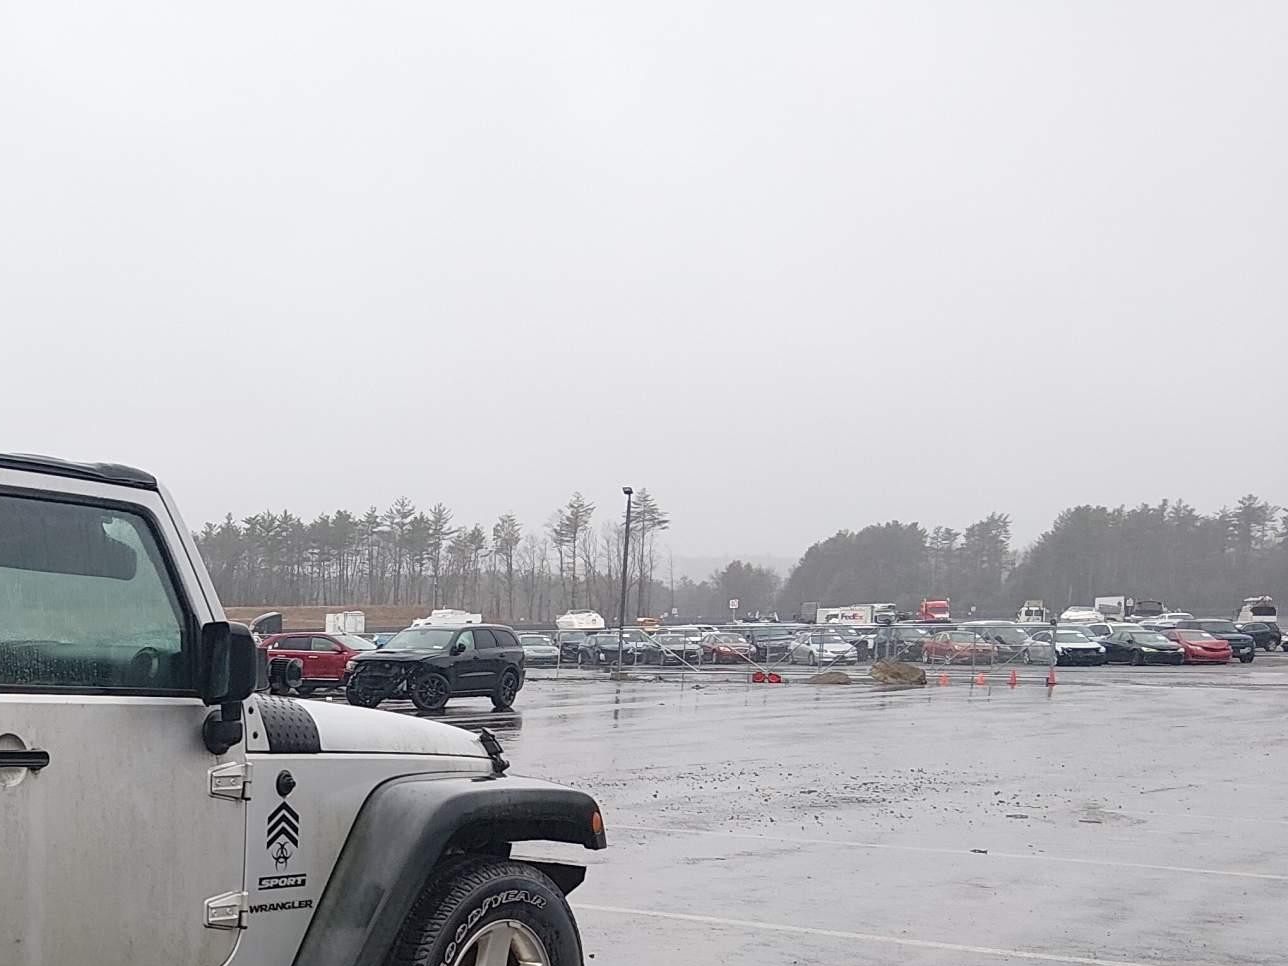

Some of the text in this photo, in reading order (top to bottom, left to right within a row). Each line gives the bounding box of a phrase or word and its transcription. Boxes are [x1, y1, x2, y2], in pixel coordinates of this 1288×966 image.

[840, 612, 864, 620] FedEx
[260, 876, 306, 888] SPORT
[249, 899, 313, 914] WRANGLER
